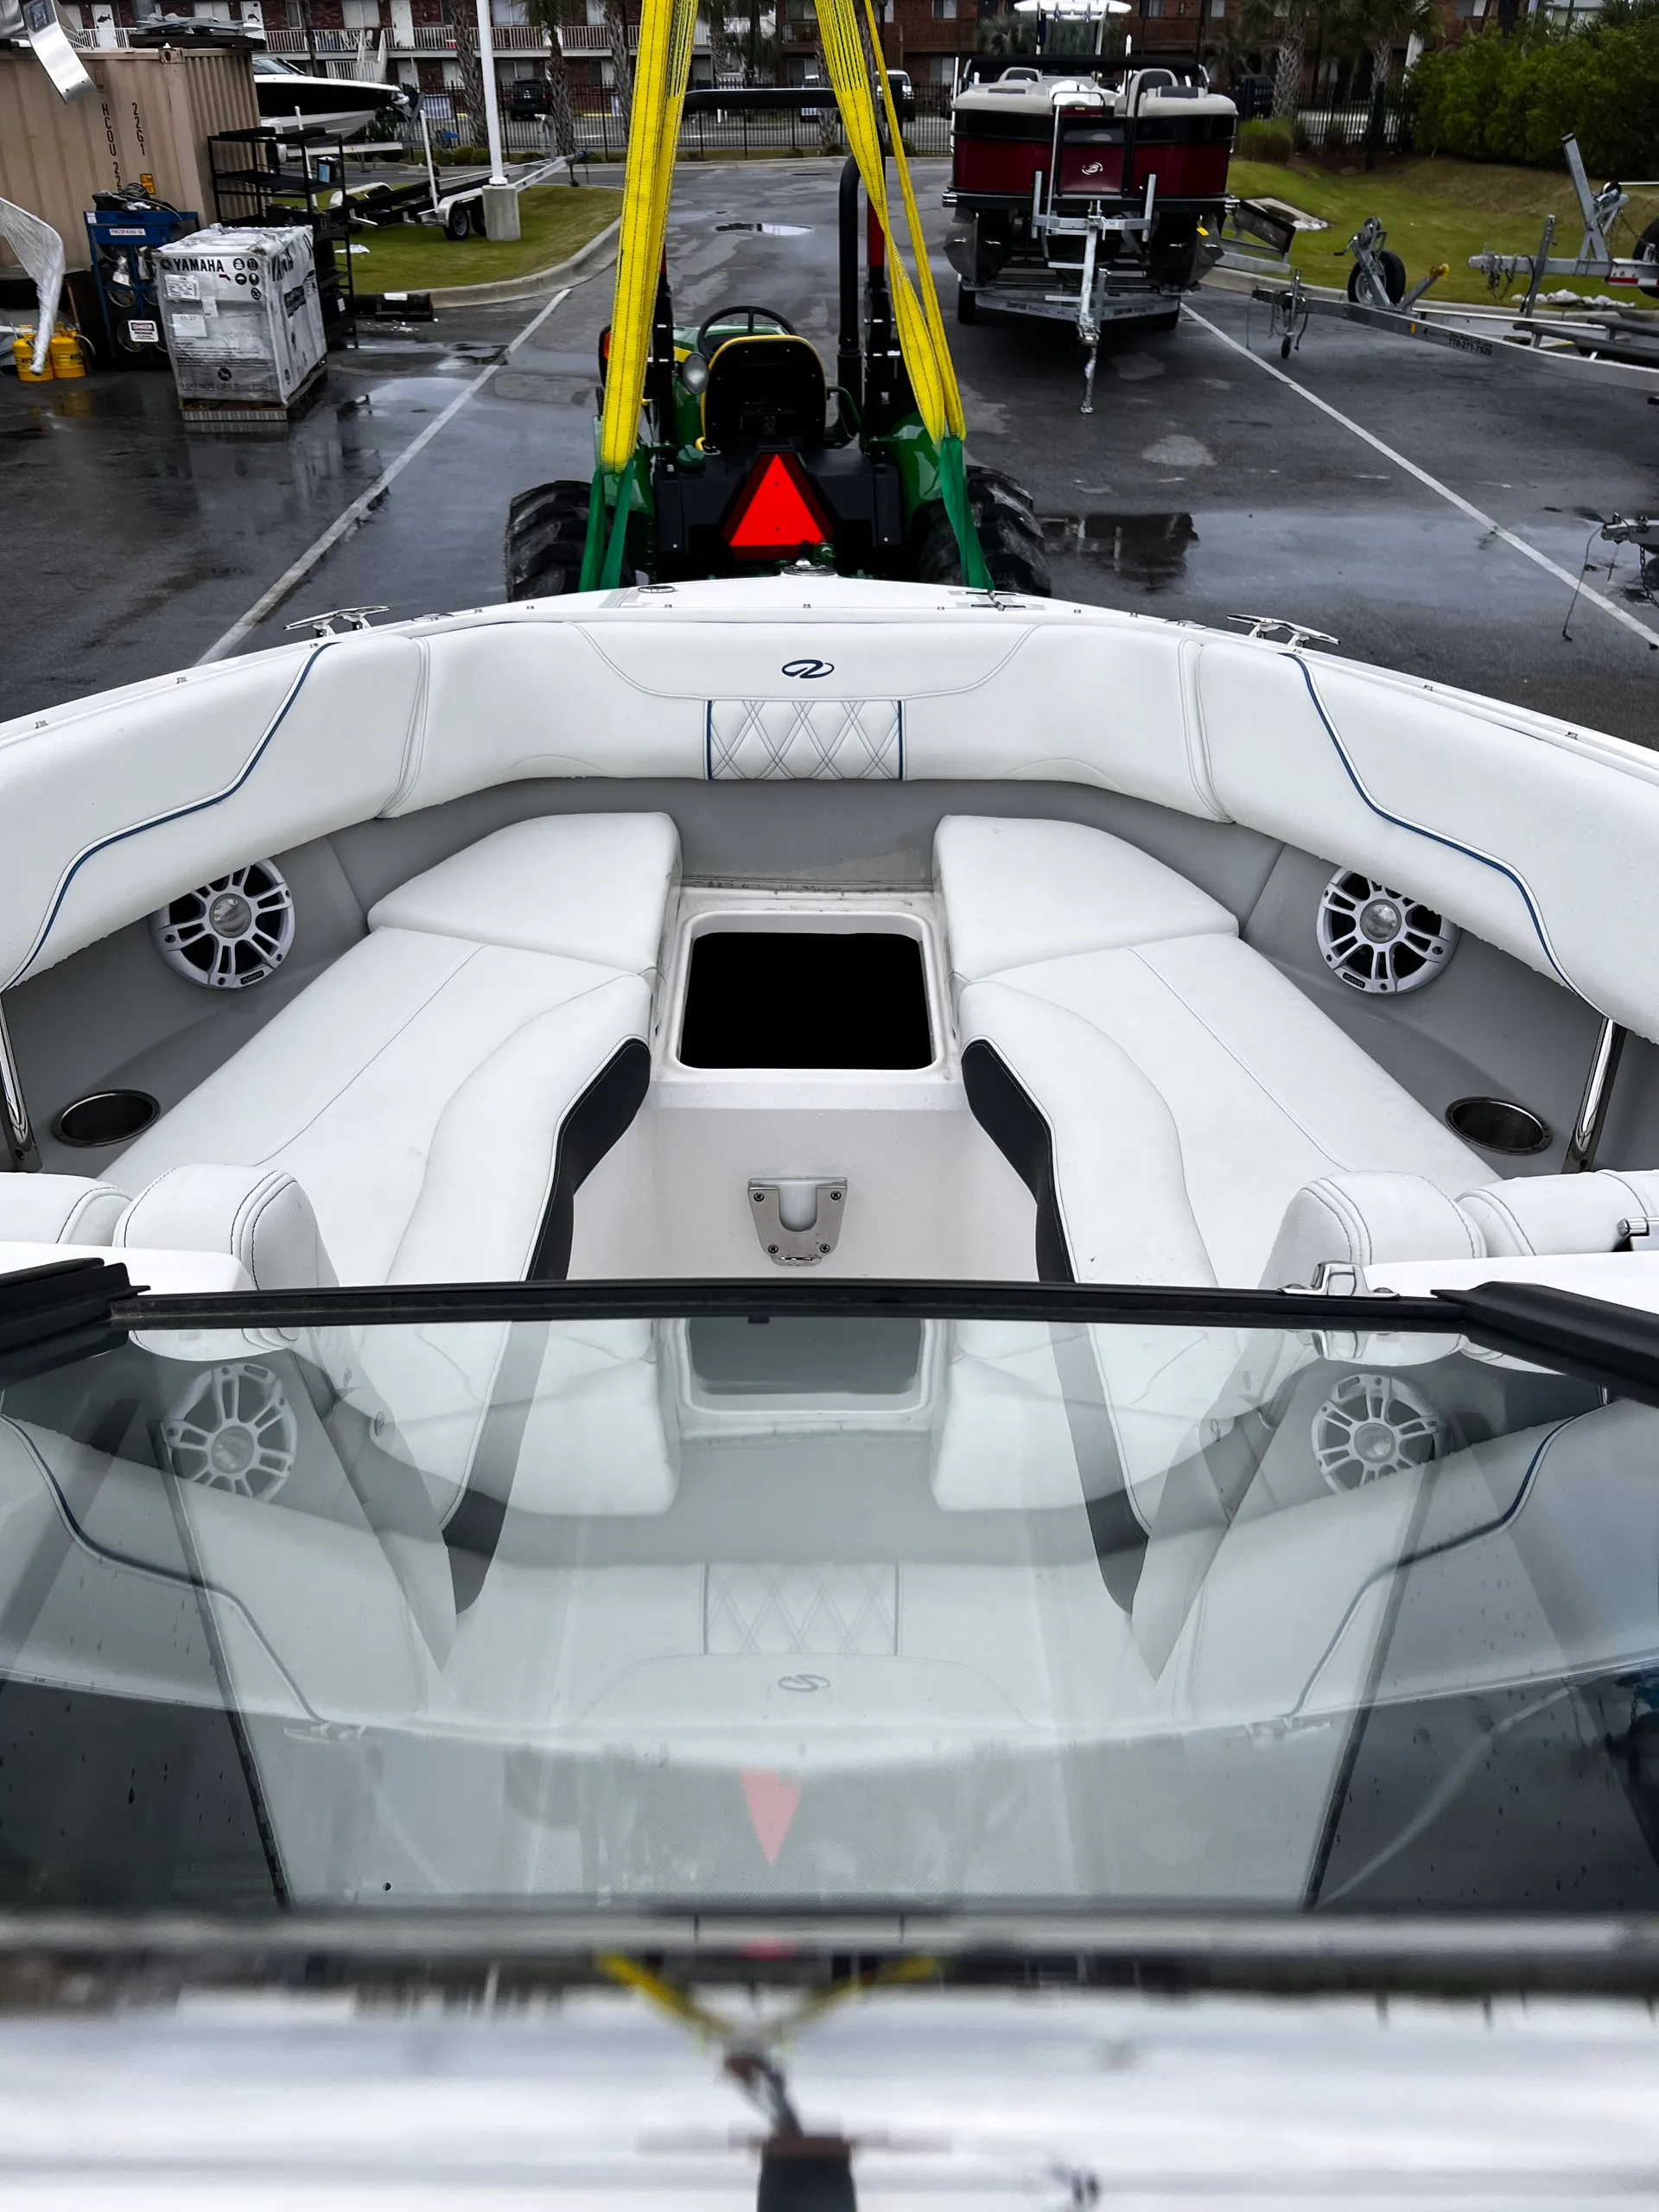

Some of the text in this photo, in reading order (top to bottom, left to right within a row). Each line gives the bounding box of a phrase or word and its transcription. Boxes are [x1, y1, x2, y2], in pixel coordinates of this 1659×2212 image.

[101, 103, 117, 156] HCOU
[132, 102, 145, 156] 22G1
[173, 258, 225, 272] YAMAHA
